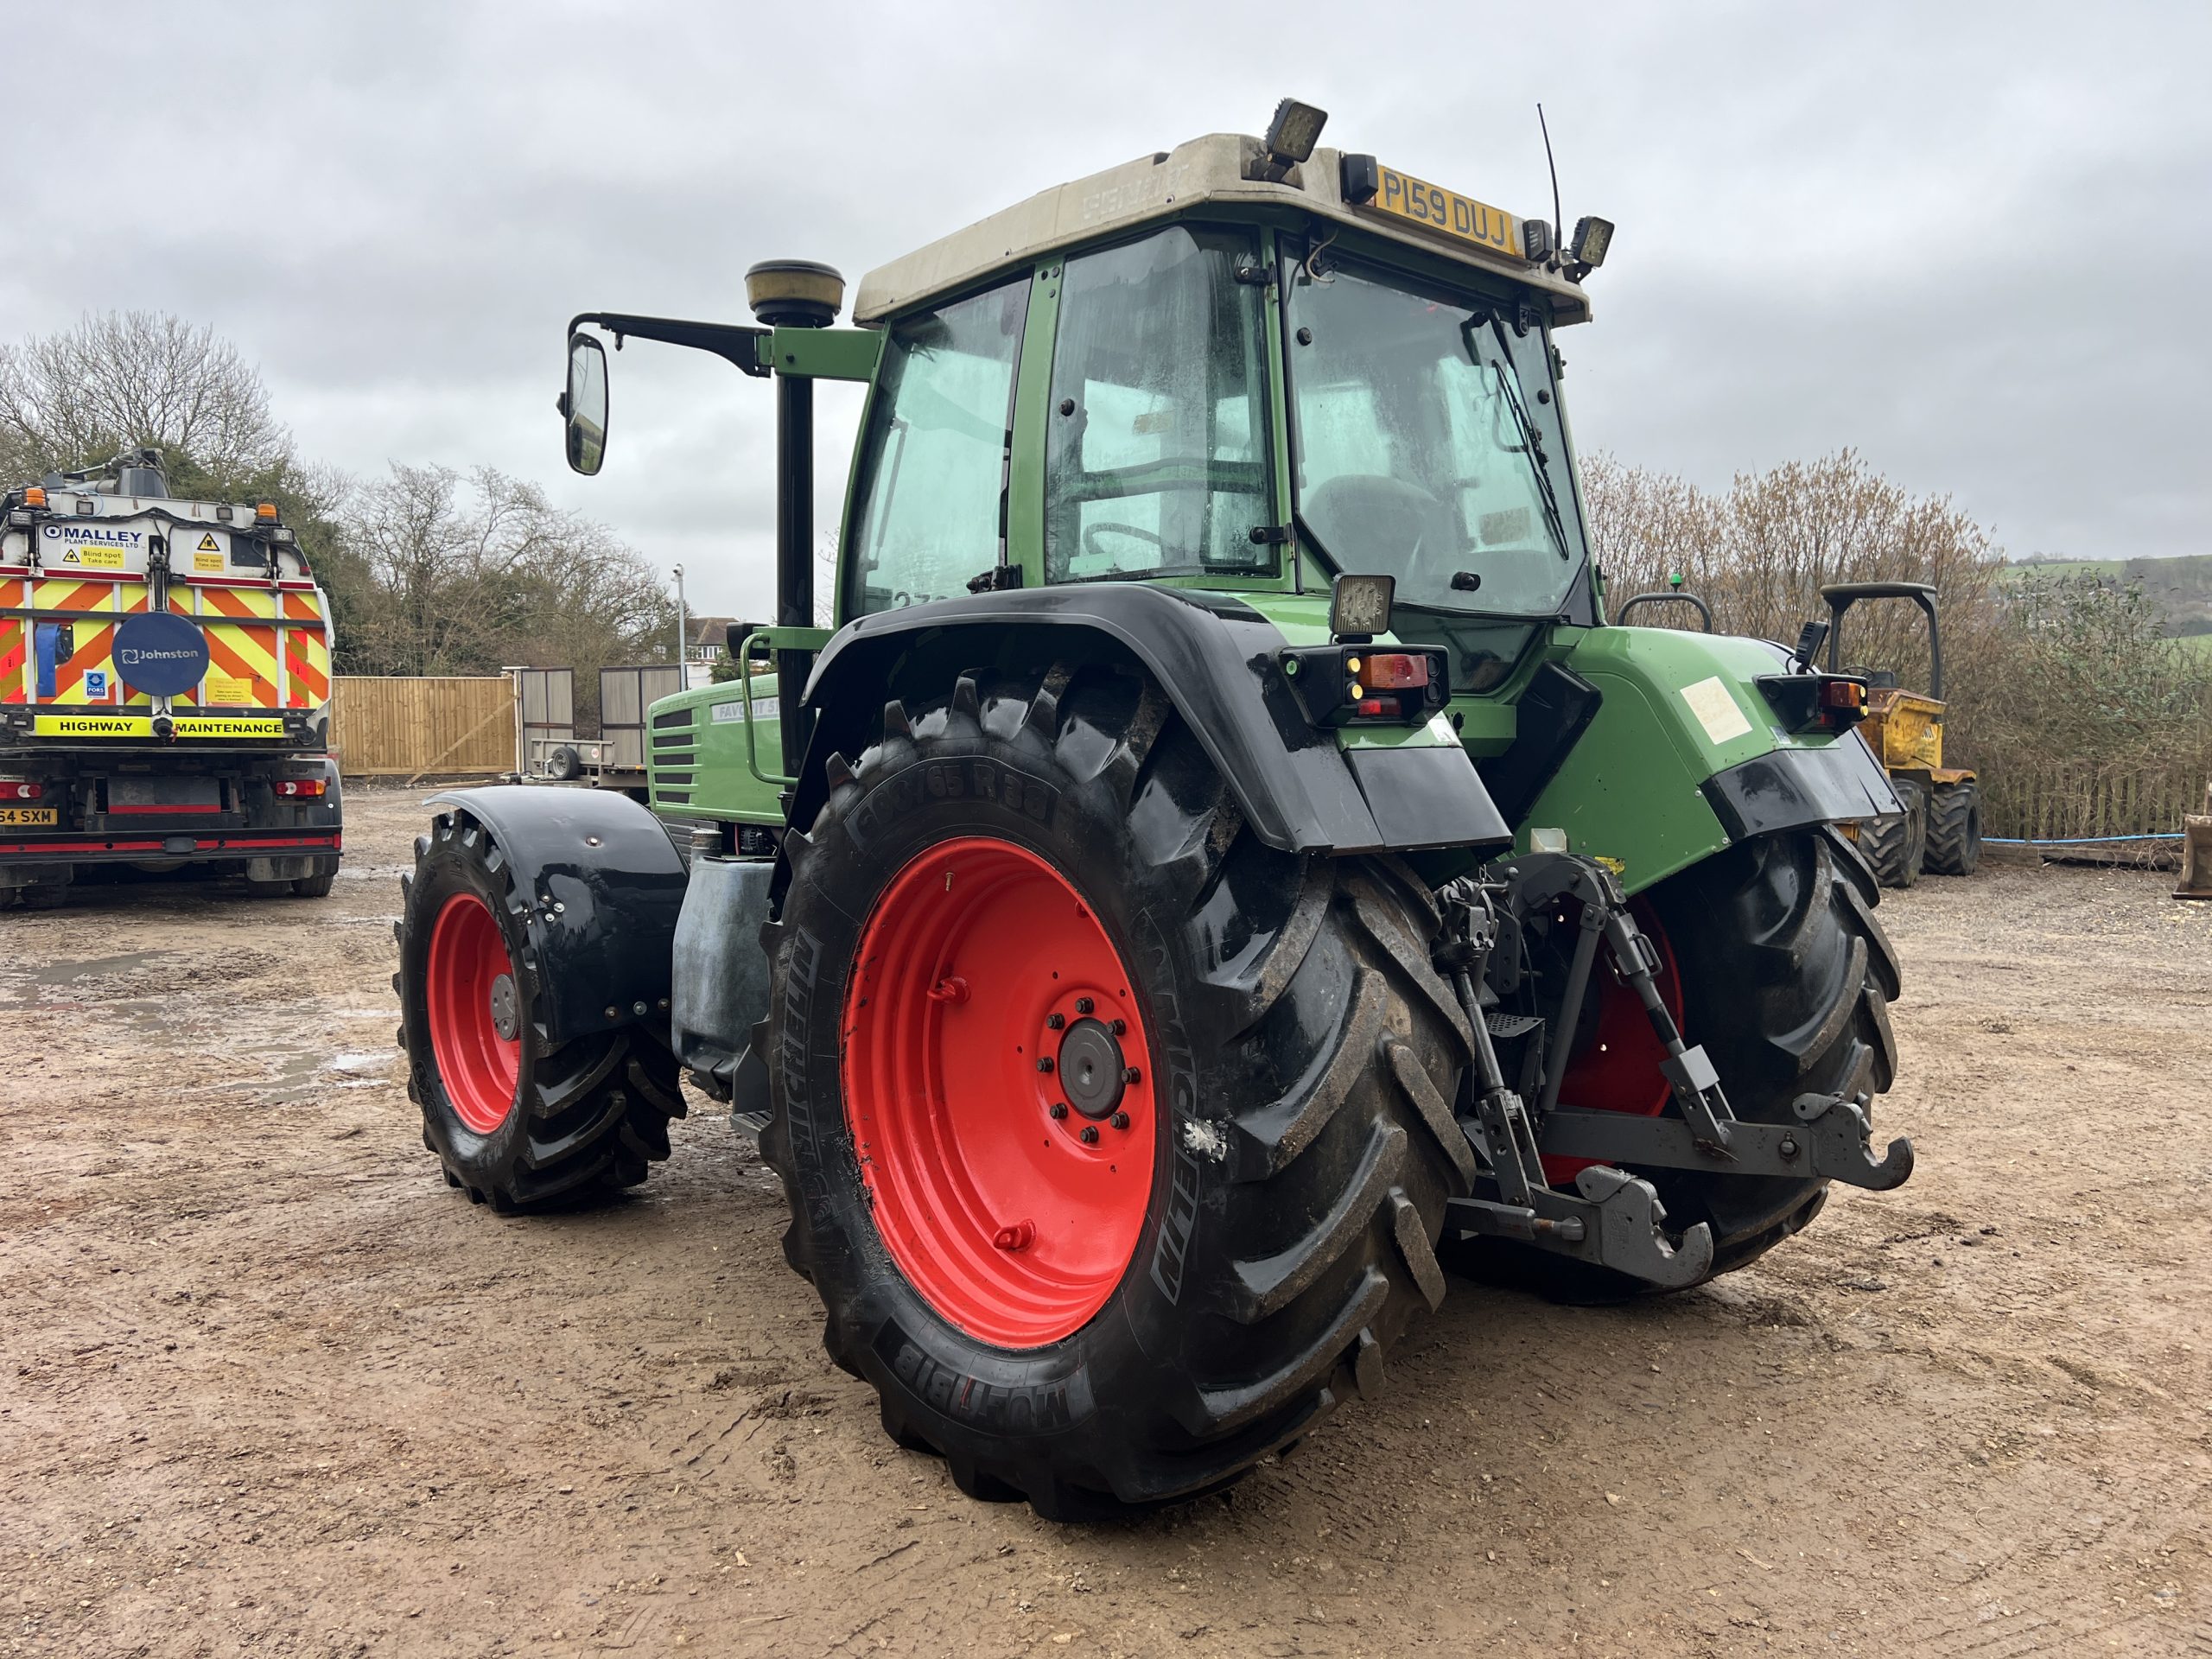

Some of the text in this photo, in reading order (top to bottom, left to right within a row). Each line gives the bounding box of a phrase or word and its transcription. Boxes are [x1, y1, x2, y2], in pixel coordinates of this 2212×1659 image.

[1383, 171, 1505, 246] P159 DUJ
[139, 650, 199, 659] Johnston
[60, 721, 283, 734] HIGHWAY MAINTENANCE
[21, 810, 51, 823] SXM
[783, 928, 822, 1166] MICHELIN
